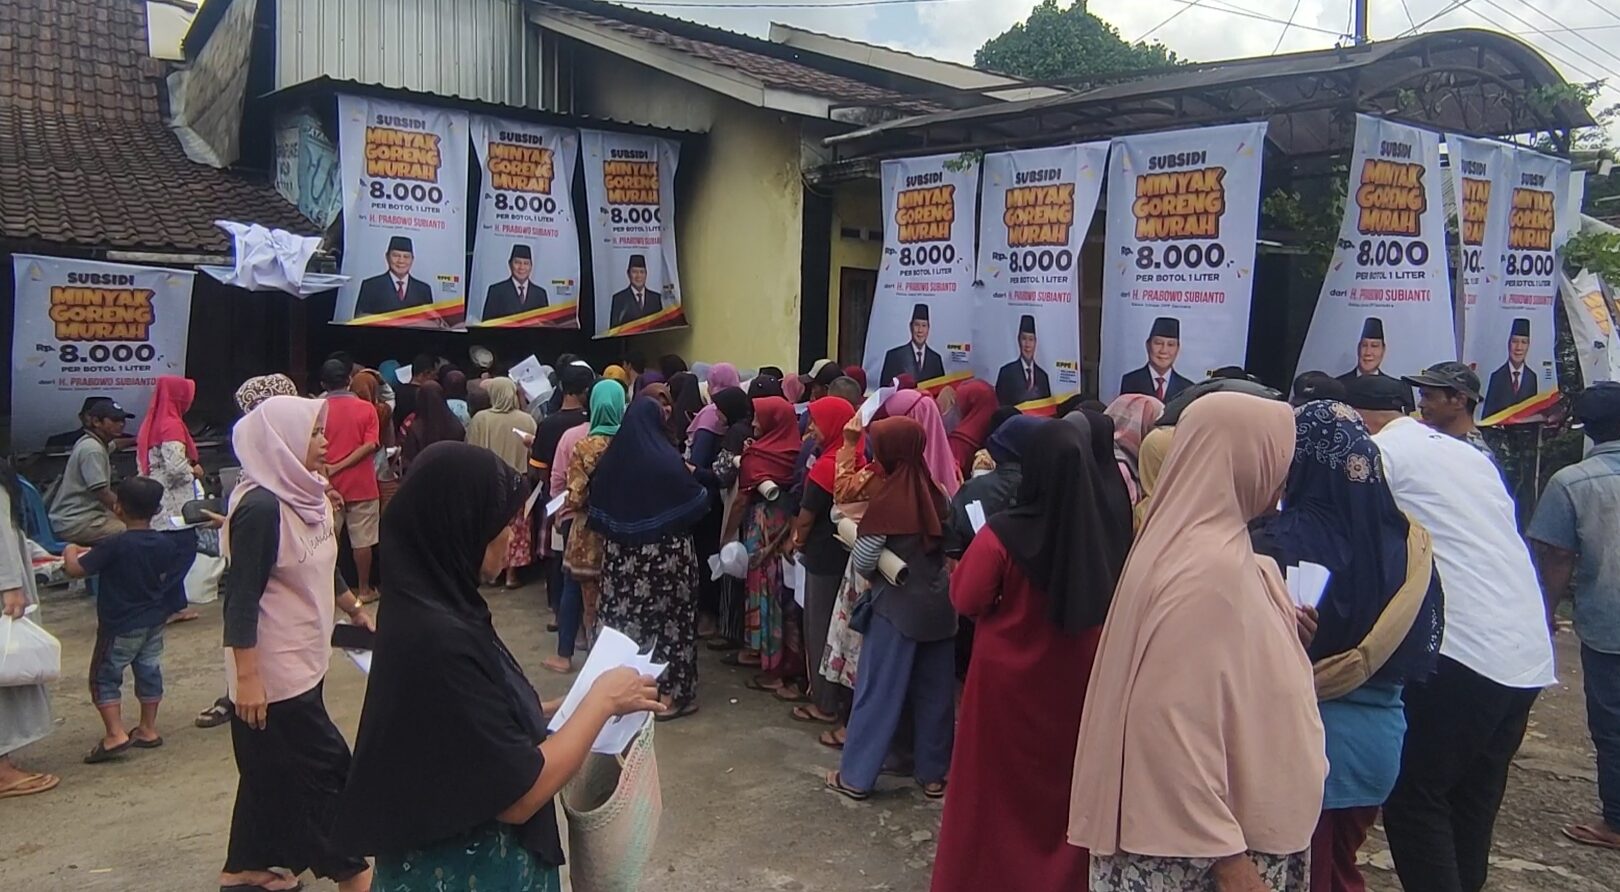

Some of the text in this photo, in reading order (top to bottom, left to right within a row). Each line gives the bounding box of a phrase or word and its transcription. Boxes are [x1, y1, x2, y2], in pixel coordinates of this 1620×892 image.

[376, 114, 426, 130] SUBSIDI
[366, 125, 441, 150] MINYAK
[499, 131, 543, 145] SUBSIDI
[365, 143, 441, 167] GORENG
[488, 142, 554, 164] MINYAK
[610, 149, 648, 159] SUBSIDI
[1381, 140, 1412, 159] SUBSIDI
[487, 158, 554, 180] GORENG
[603, 160, 659, 177] MINYAK
[1149, 151, 1207, 170] SUBSIDI
[366, 160, 438, 184] MURAH
[604, 174, 659, 190] GORENG
[906, 172, 942, 187] SUBSIDI
[1015, 168, 1062, 184] SUBSIDI
[1136, 166, 1226, 198] MINYAK
[491, 172, 551, 194] MURAH
[607, 188, 659, 205] MURAH
[897, 184, 955, 209] MINYAK
[1005, 183, 1075, 208] MINYAK
[1132, 191, 1225, 218] GORENG
[1355, 183, 1427, 213] GORENG
[895, 204, 954, 225] GORENG
[1003, 204, 1074, 227] GORENG
[1357, 208, 1421, 237] MURAH
[898, 221, 951, 243] MURAH
[1008, 223, 1069, 247] MURAH
[1135, 215, 1219, 241] MURAH
[1009, 249, 1073, 273] 8.000
[1356, 240, 1429, 266] 8.000
[936, 267, 952, 275] LITER
[1389, 271, 1393, 279] 1
[1395, 271, 1426, 279] LITER
[1506, 254, 1554, 276] 8.000
[67, 272, 135, 285] SUBSIDI
[1156, 274, 1186, 282] BOTOL
[1194, 273, 1220, 281] LITER
[51, 286, 155, 306] MINYAK
[1142, 289, 1182, 302] PRABOWO
[1183, 291, 1225, 304] SUBIANTO
[1329, 289, 1347, 297] dari
[49, 304, 155, 324] GORENG
[55, 321, 149, 340] MURAH
[71, 378, 113, 386] PRABOWO
